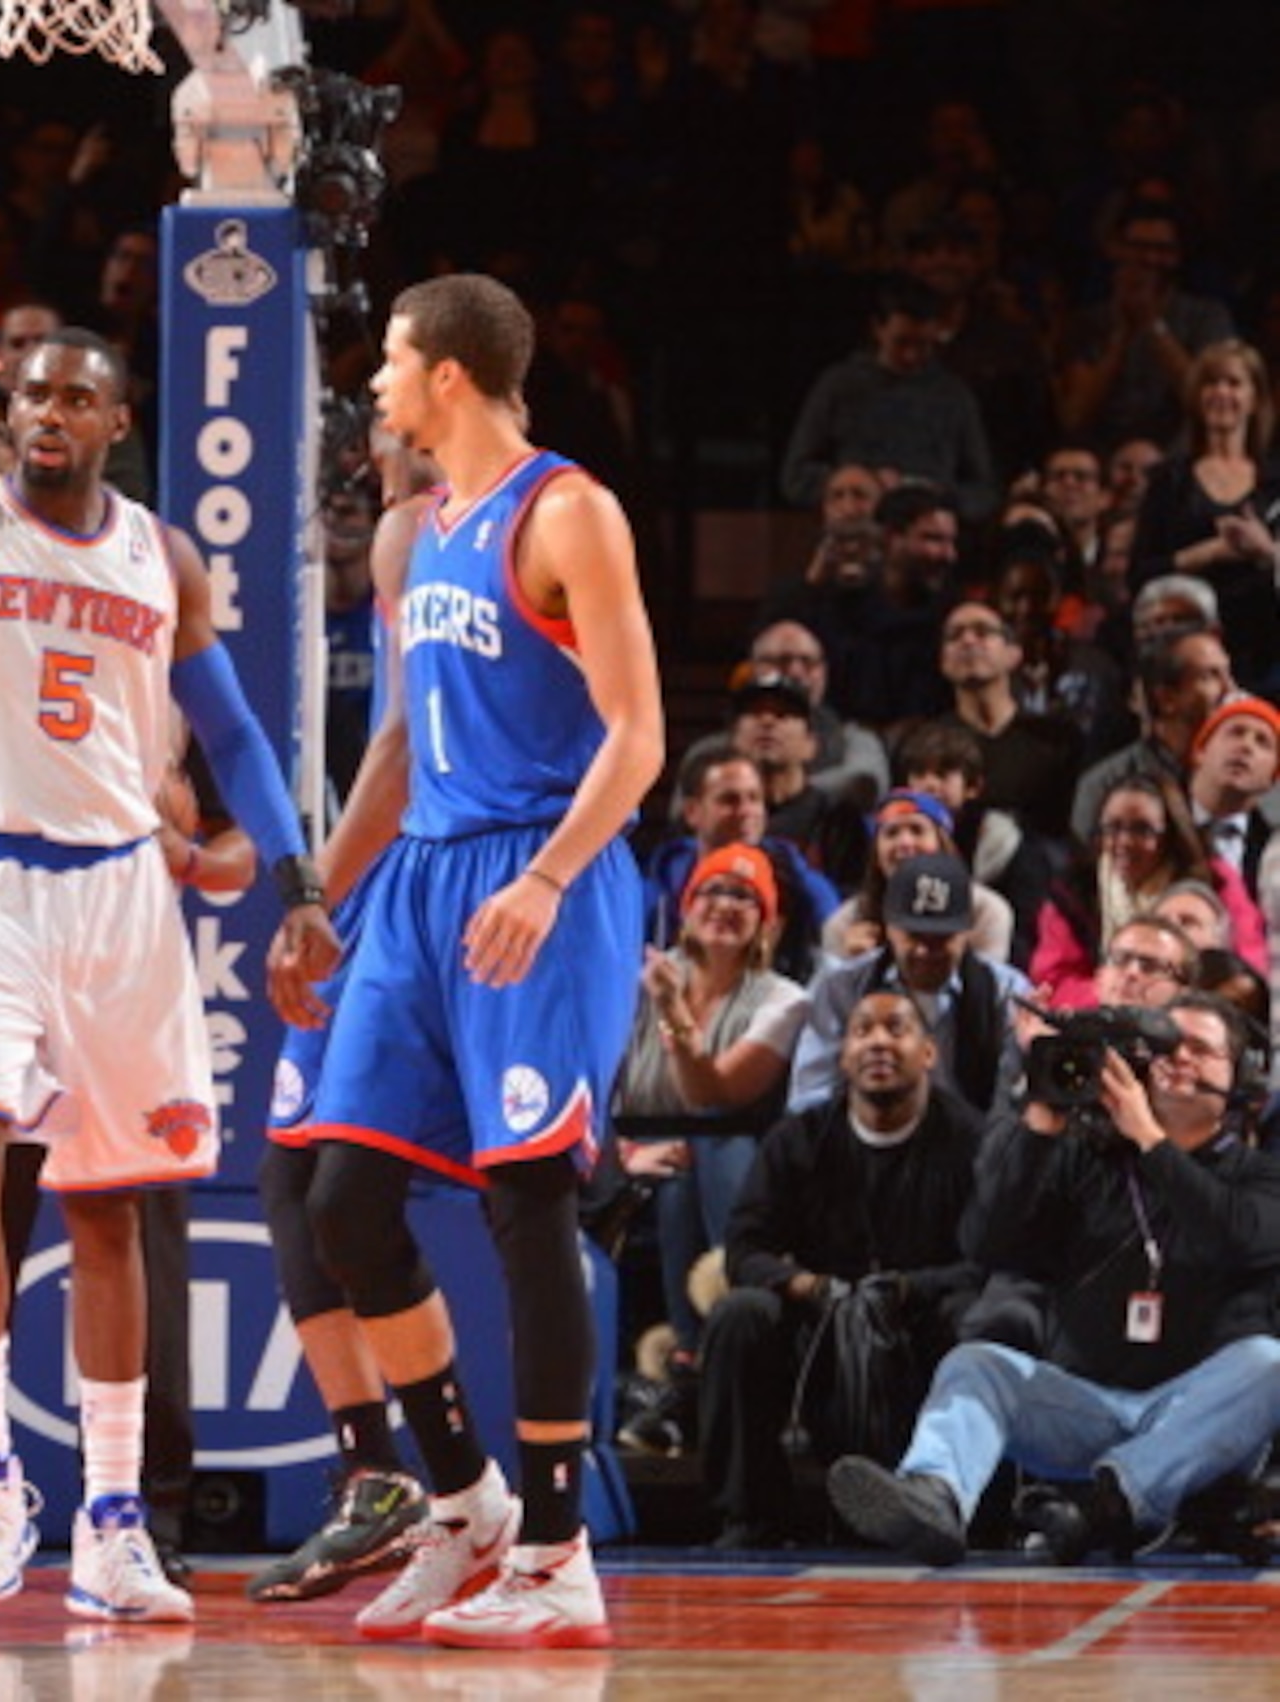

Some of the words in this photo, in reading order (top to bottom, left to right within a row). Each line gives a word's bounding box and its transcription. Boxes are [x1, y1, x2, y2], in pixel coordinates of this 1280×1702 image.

[196, 325, 254, 632] Foot
[53, 582, 165, 656] YORK
[37, 646, 95, 744] 5
[427, 687, 452, 774] 1
